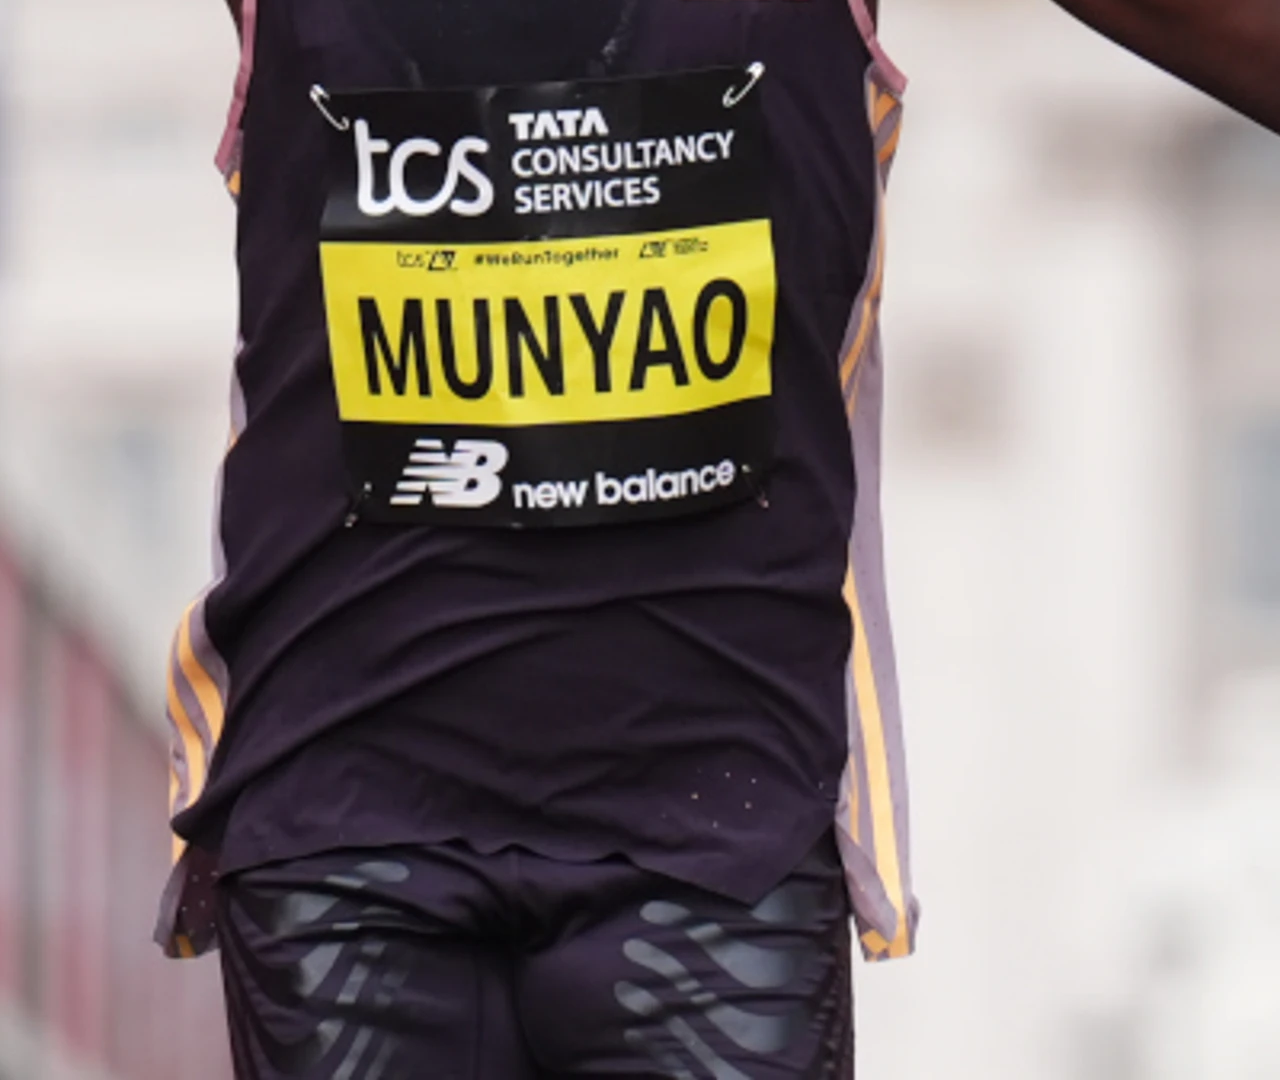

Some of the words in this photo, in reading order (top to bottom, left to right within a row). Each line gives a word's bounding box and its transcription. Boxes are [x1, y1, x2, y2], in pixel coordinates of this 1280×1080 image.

[509, 107, 609, 140] TATA
[354, 119, 494, 216] tcs
[511, 131, 735, 178] CONSULTANCY
[514, 177, 661, 214] SERVICES
[474, 248, 619, 267] #WeRunTogether
[358, 278, 748, 400] MUNYAO
[513, 481, 587, 510] new
[596, 459, 736, 507] balance
